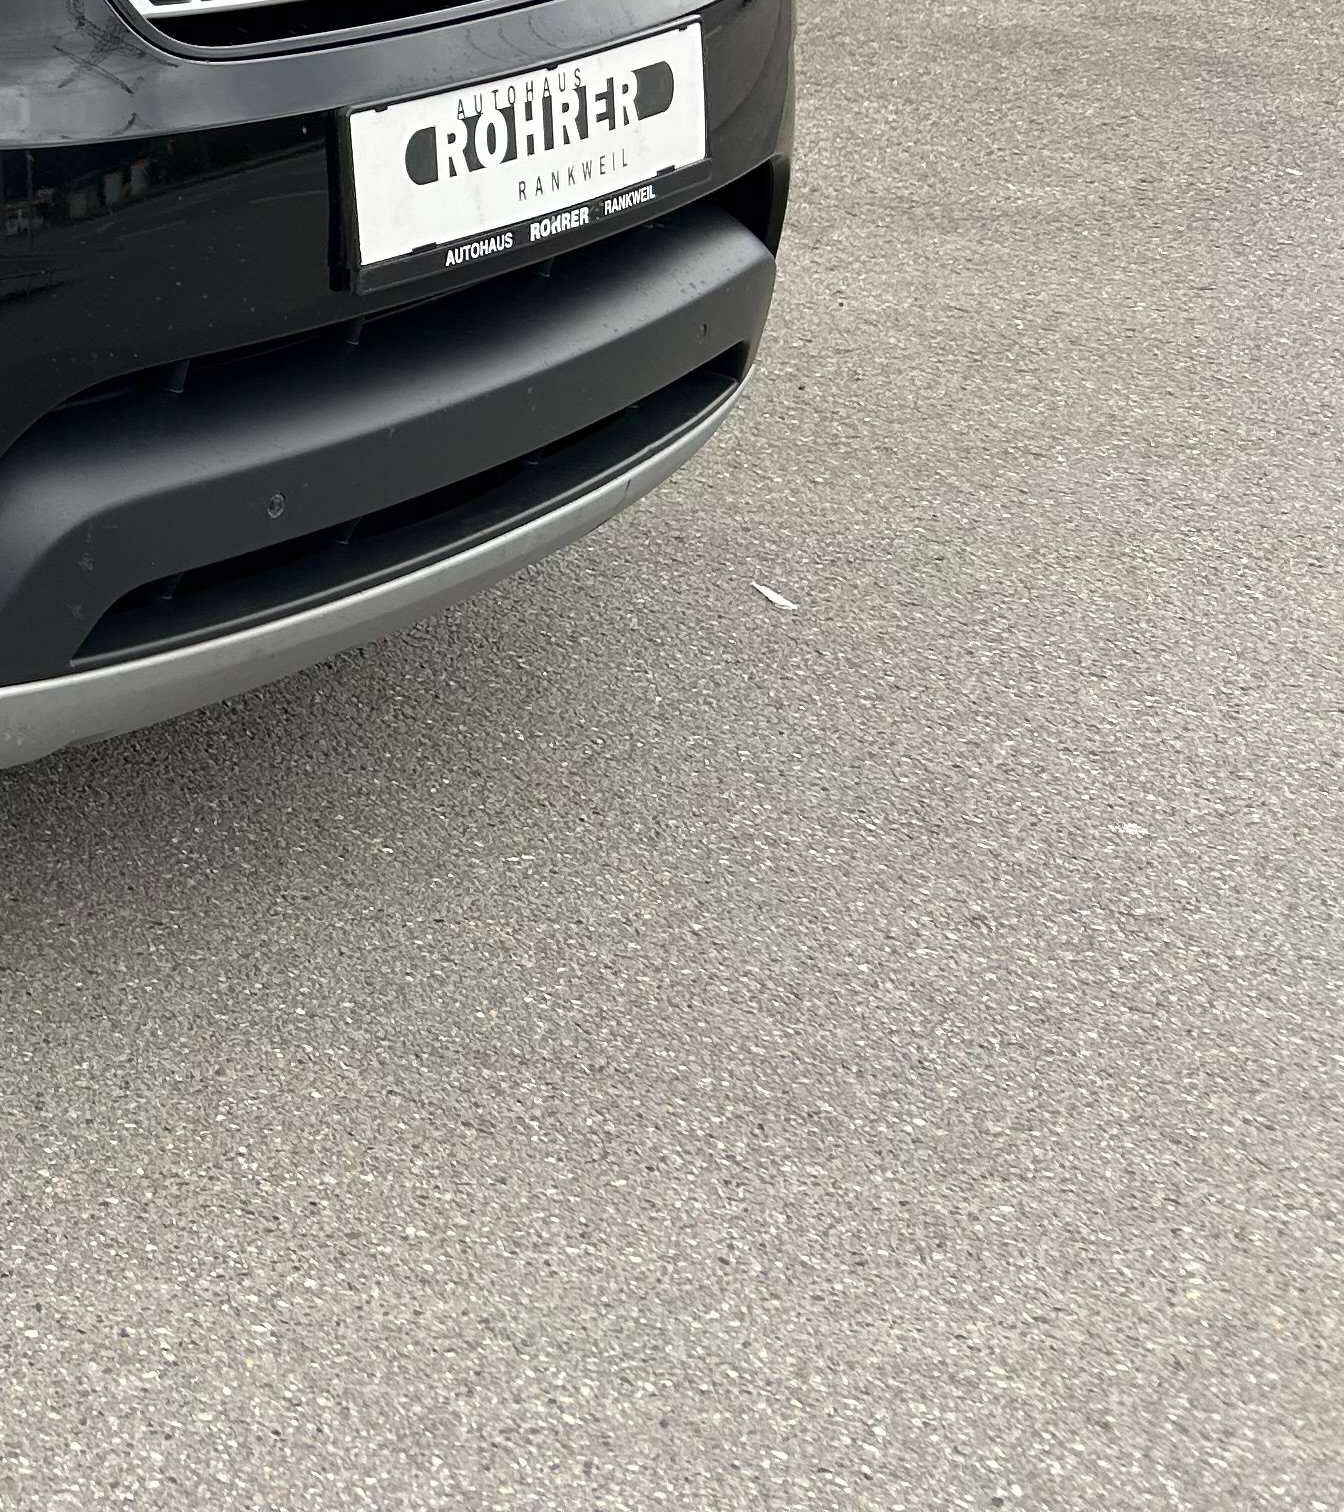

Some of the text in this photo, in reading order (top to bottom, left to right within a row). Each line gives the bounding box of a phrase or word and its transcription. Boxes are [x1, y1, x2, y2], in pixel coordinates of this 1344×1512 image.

[434, 69, 642, 180] ROHRER
[457, 68, 583, 120] AUTOHAUS
[518, 148, 629, 202] RANKWEIL
[445, 185, 656, 267] AUTOHAUS ROHRER RANKWEIL
